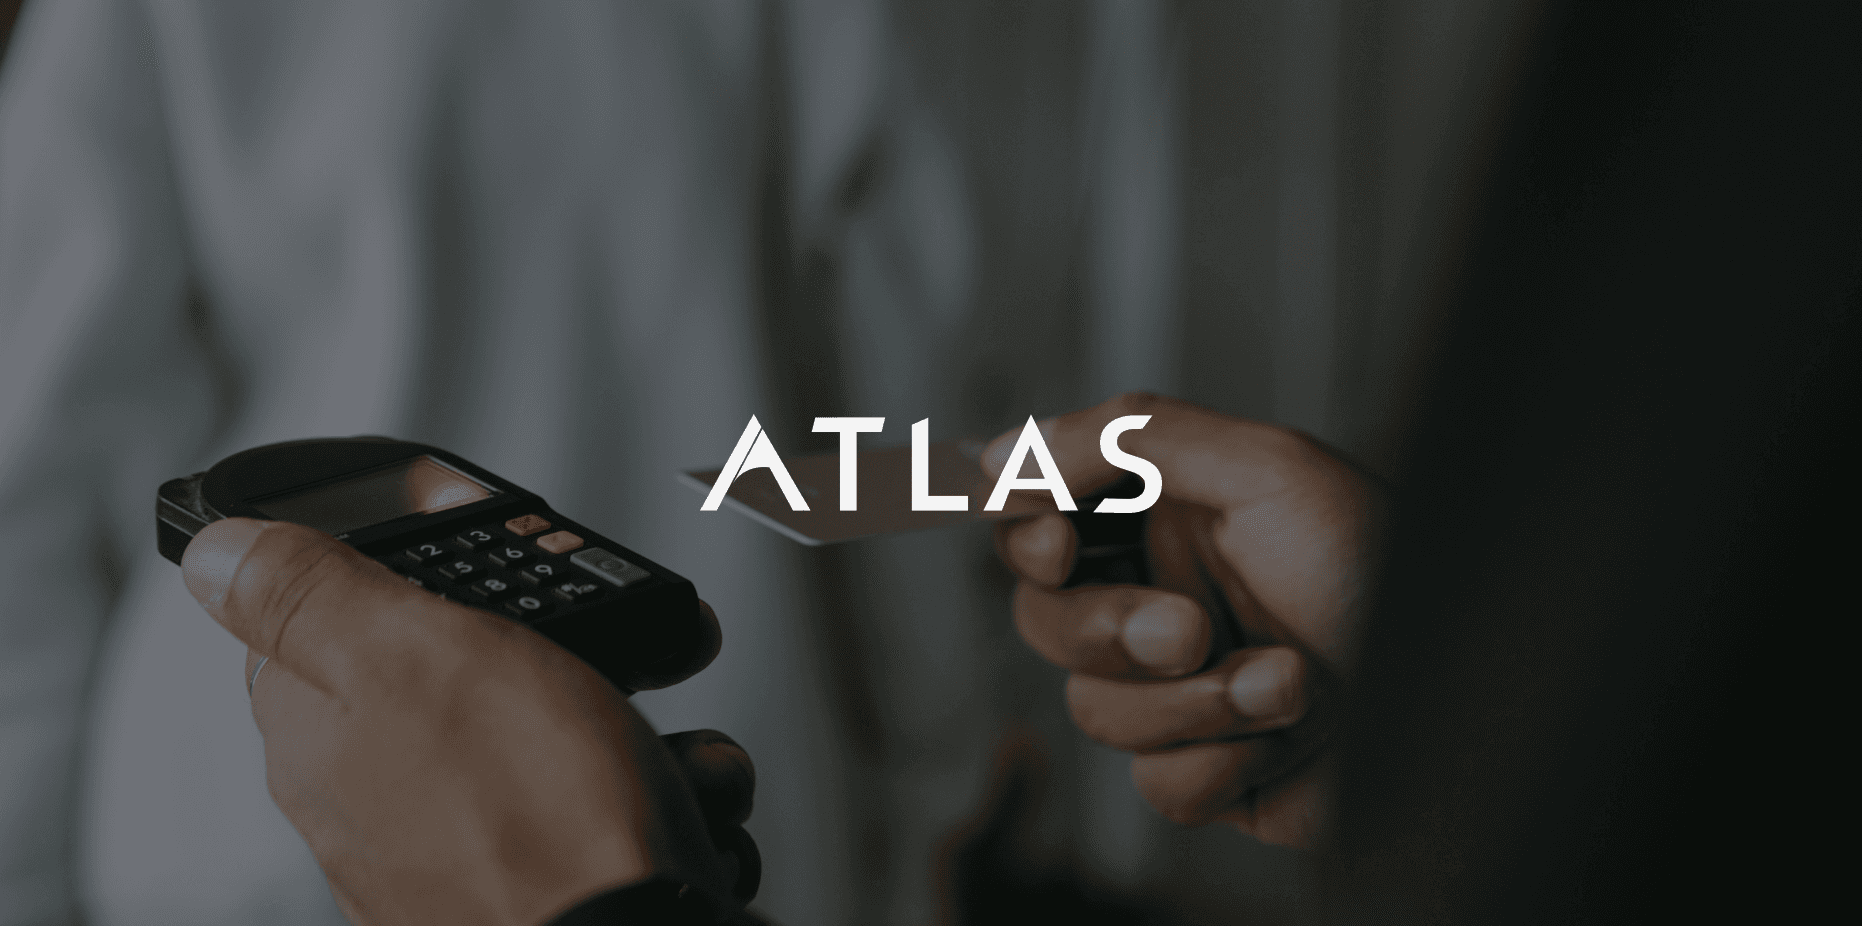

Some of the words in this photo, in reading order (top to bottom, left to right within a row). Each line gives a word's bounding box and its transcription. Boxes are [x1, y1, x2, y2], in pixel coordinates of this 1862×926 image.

[470, 531, 491, 541] 3
[420, 545, 443, 556] 2
[506, 548, 524, 558] 6
[455, 562, 473, 573] 5
[534, 564, 553, 575] 9
[485, 579, 507, 591] 8
[518, 596, 541, 610] 0
